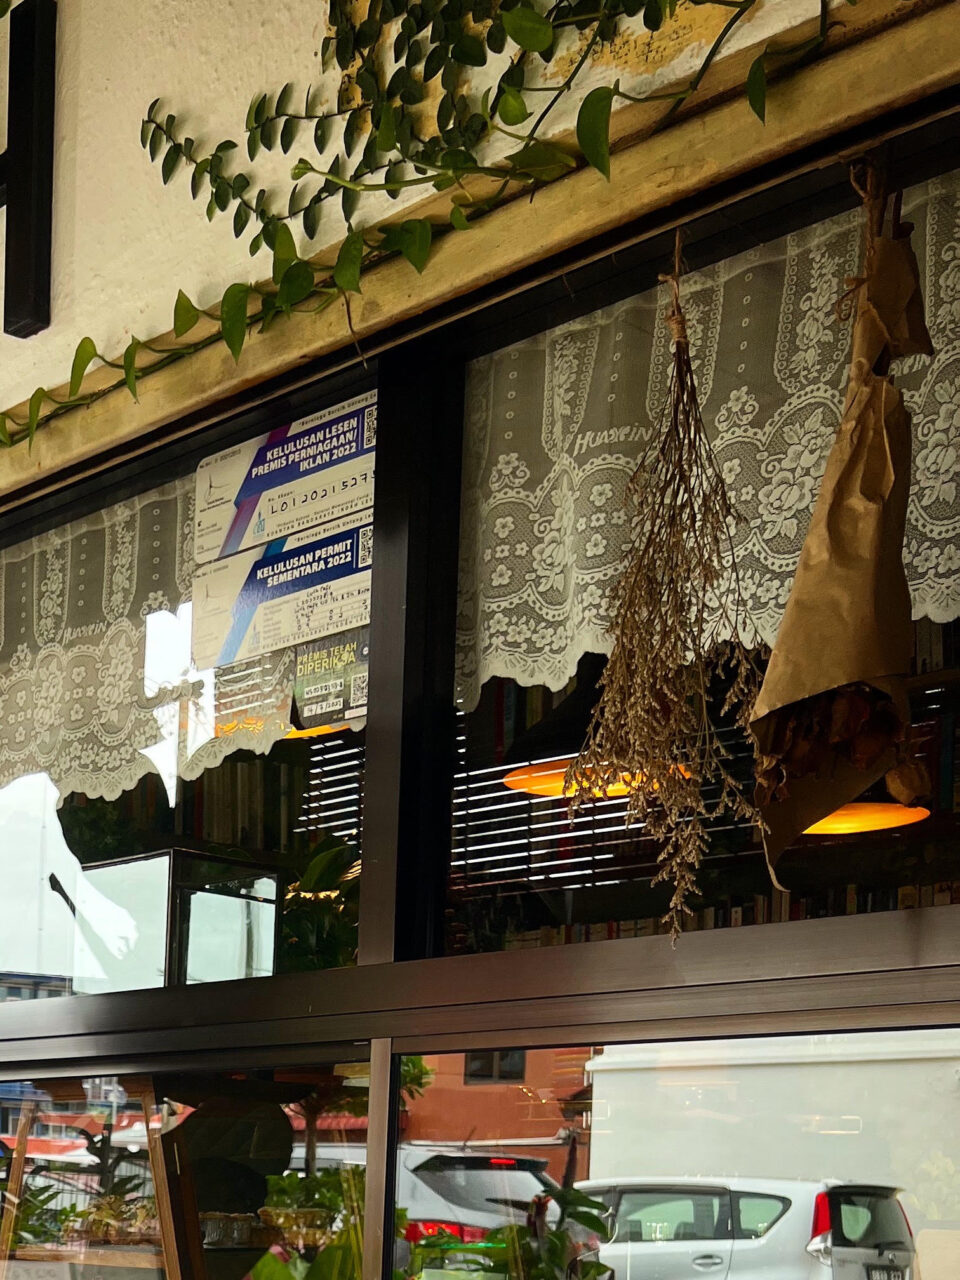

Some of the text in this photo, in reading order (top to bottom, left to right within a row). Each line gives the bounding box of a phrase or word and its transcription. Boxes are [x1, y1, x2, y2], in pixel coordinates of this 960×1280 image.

[251, 456, 287, 478] PREMIS
[288, 429, 358, 467] PERNIAGAAN/
[266, 430, 324, 461] KELULUSAN
[325, 417, 358, 438] LESEN
[299, 442, 357, 472] IKLAN 2022
[256, 552, 314, 580] KELULUSAN
[315, 539, 353, 563] PERMIT
[266, 552, 353, 587] SEMENTARA 2022
[296, 652, 357, 677] DIPERIKSA
[297, 650, 328, 665] PREMIS
